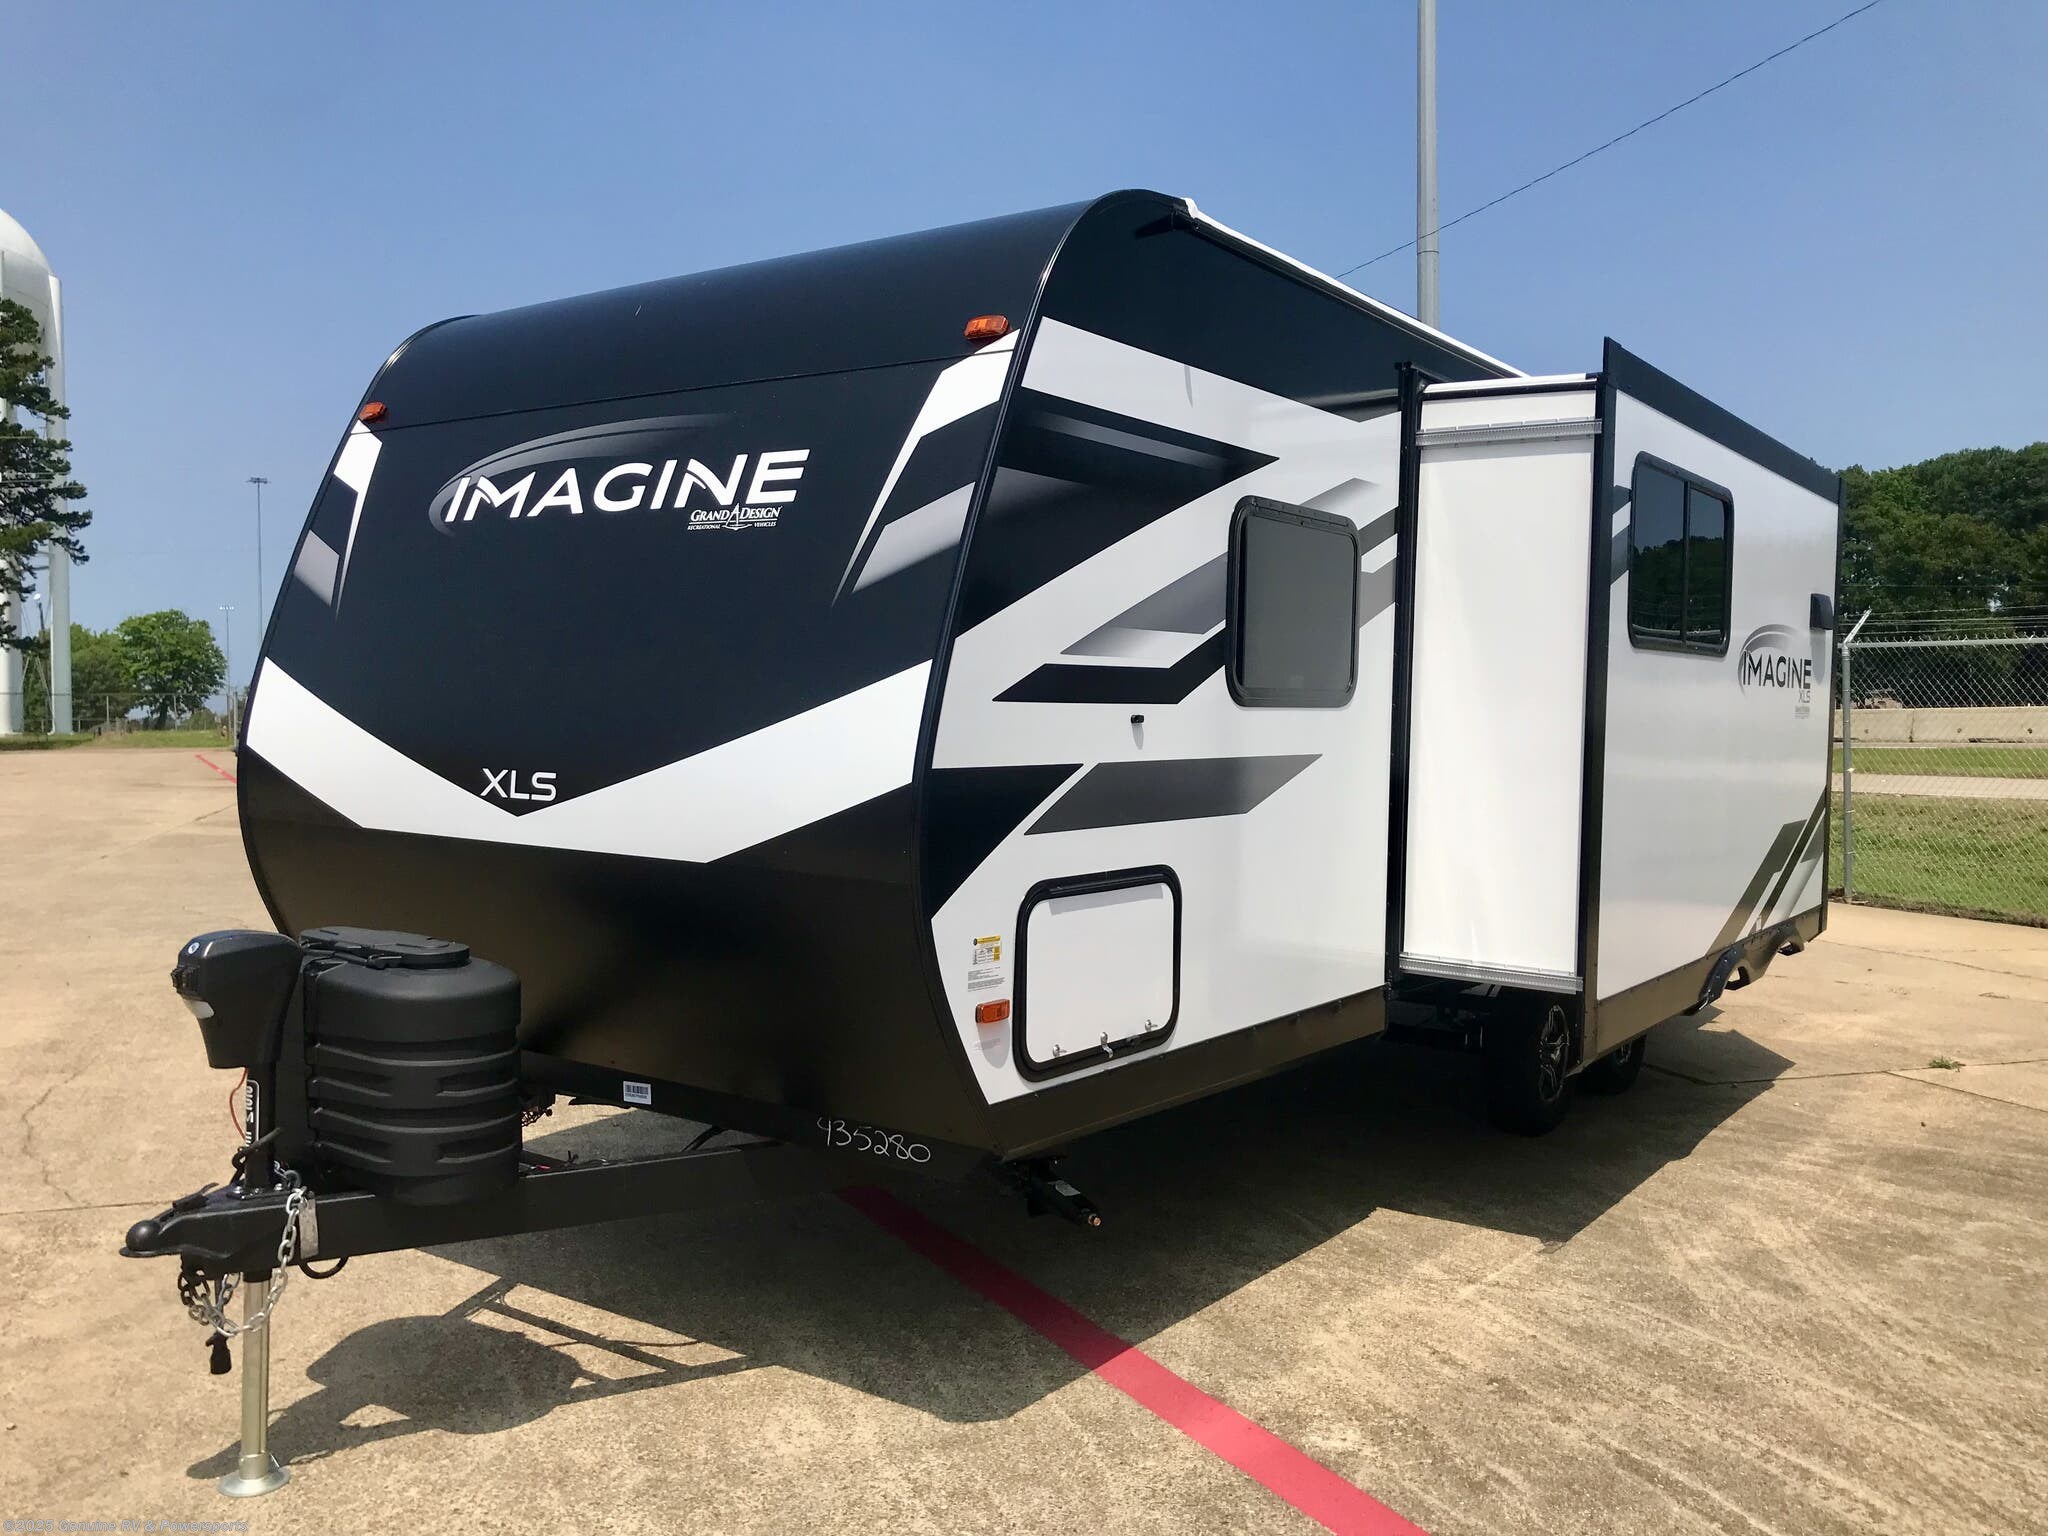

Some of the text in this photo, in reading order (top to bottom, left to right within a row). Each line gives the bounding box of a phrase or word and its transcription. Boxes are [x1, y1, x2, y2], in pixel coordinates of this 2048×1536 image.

[444, 448, 811, 523] IMAGINE
[690, 506, 782, 522] GRAND DESIGN
[1743, 650, 1812, 689] IMAGINE
[1798, 690, 1811, 704] XLS
[480, 767, 557, 802] XLS
[816, 1116, 931, 1163] 435280
